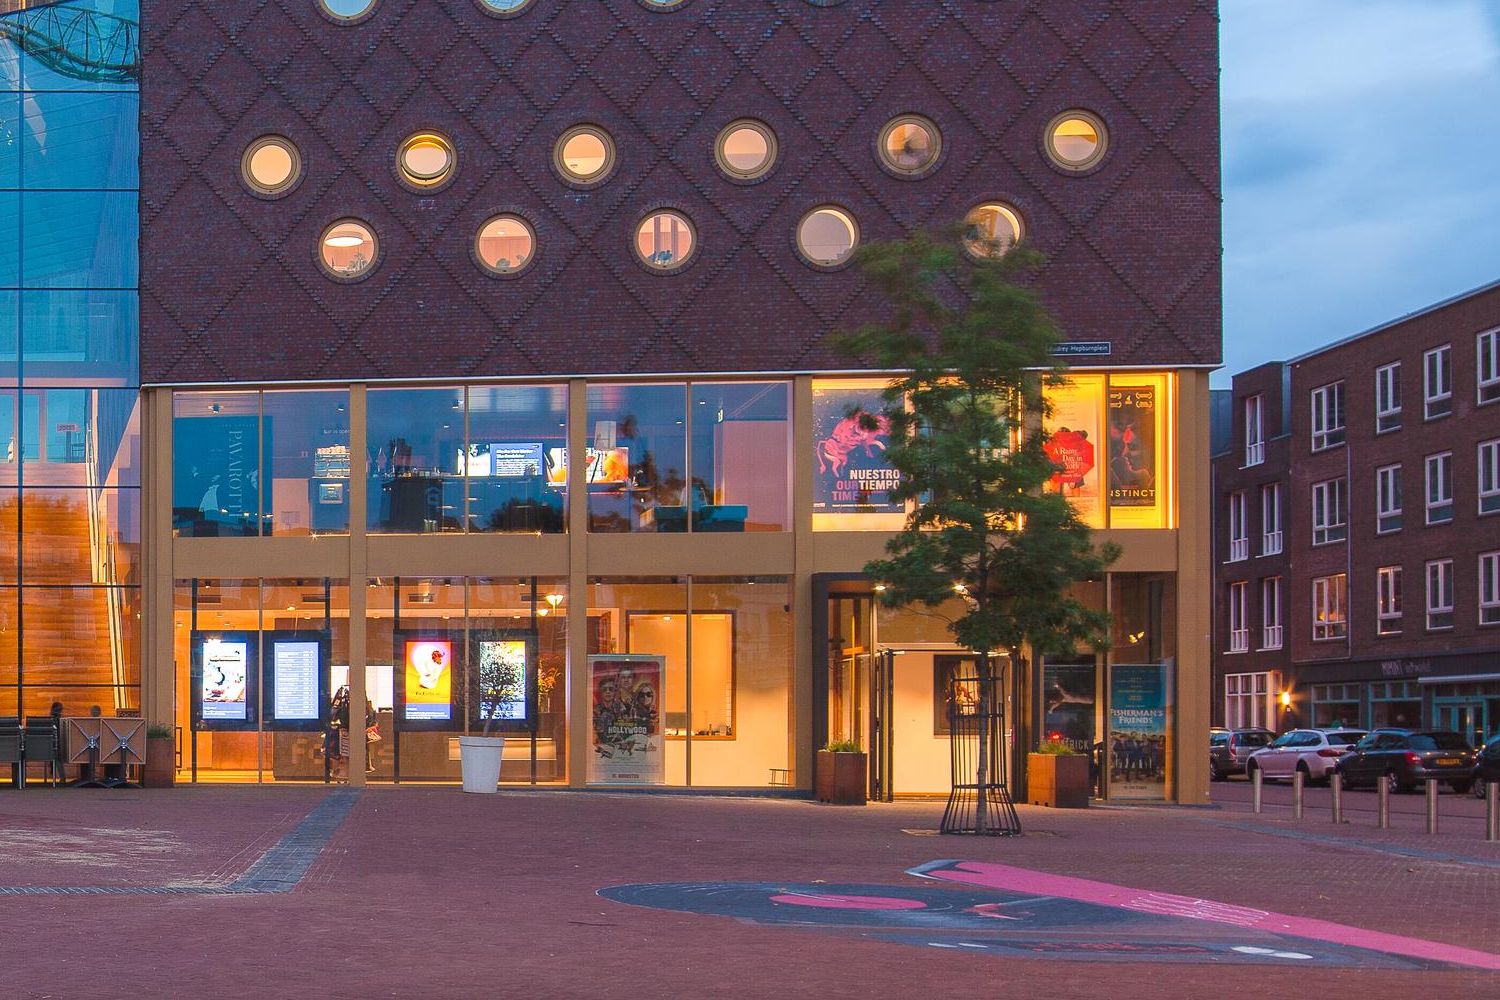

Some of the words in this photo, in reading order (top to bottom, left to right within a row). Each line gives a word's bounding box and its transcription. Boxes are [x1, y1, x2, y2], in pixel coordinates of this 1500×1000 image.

[1053, 447, 1059, 455] A
[228, 430, 243, 518] PAVAROTTI
[850, 469, 900, 480] NUESTRO
[836, 480, 858, 490] OUR
[859, 480, 900, 490] TIEMPO
[831, 491, 858, 501] TIME
[1119, 716, 1153, 725] FRIENDS
[608, 726, 647, 734] HOLLYWOOD
